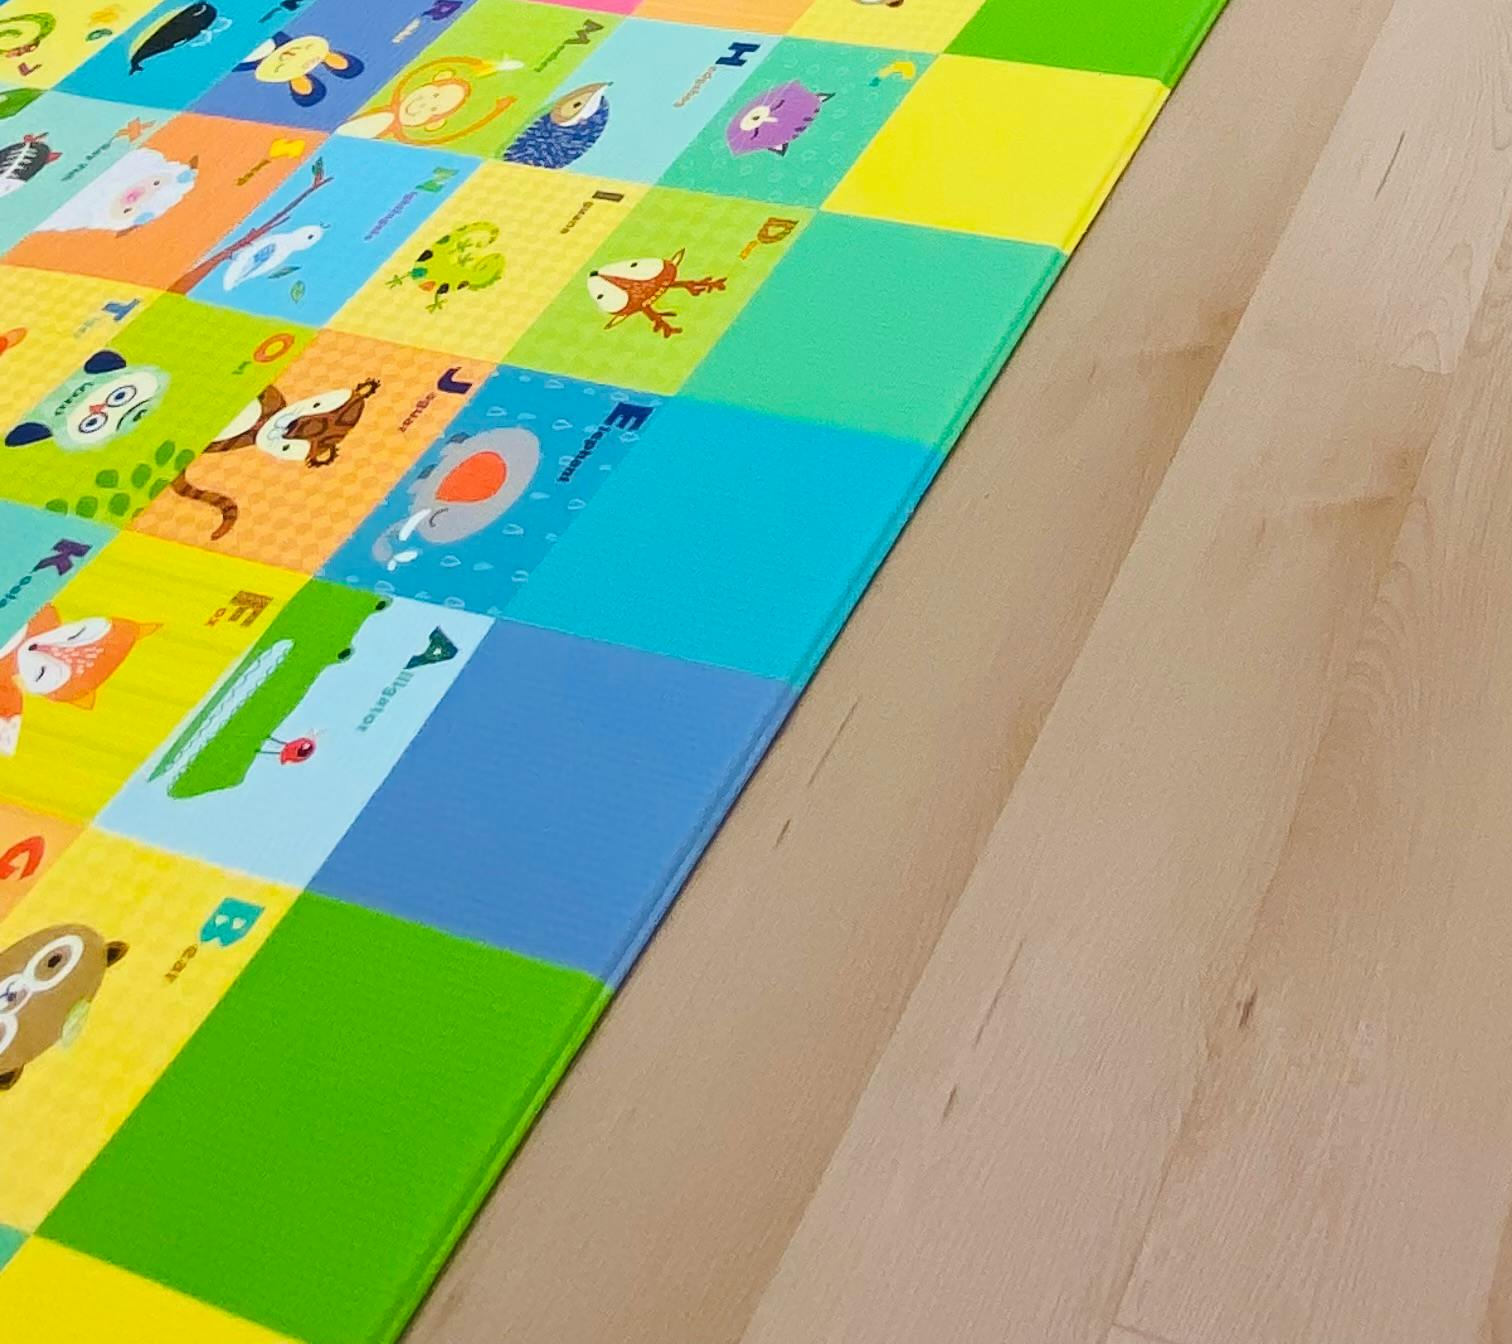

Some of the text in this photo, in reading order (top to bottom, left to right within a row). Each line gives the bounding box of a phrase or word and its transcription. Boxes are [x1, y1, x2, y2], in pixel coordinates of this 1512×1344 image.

[556, 401, 656, 484] Elephant
[356, 625, 459, 733] Alligator
[164, 897, 265, 985] Bear
